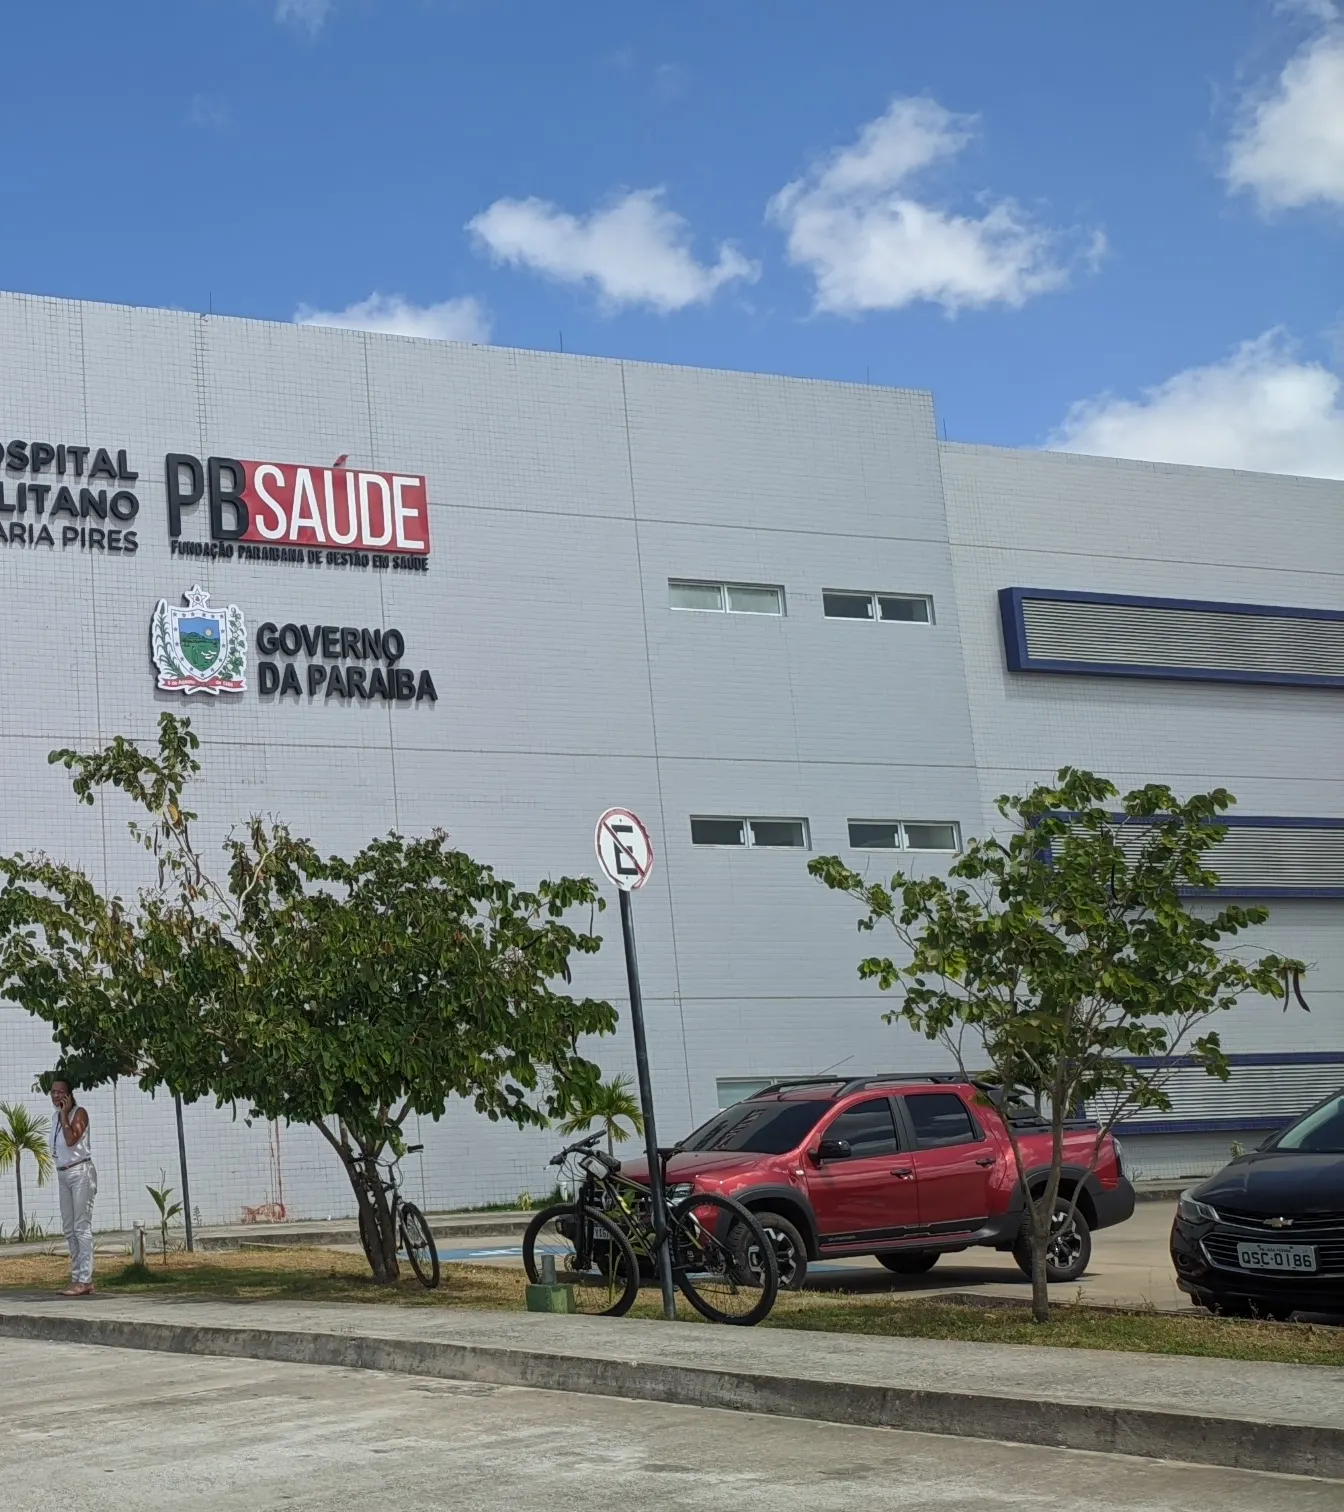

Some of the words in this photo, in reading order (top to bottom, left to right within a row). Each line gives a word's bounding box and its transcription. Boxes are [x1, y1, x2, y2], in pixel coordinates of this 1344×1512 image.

[166, 452, 250, 540] PB
[254, 454, 425, 550] SAÚDE
[62, 525, 139, 552] PIRES
[170, 539, 235, 559] FUNDAÇÃO
[238, 544, 306, 563] PARAIBANA
[307, 549, 324, 565] DE
[326, 549, 370, 568] GESTÃO
[372, 554, 390, 569] EM
[392, 553, 430, 572] SAÚDE
[256, 621, 405, 661] GOVERNO
[258, 661, 304, 696] DA
[307, 659, 439, 701] PARAÍBA
